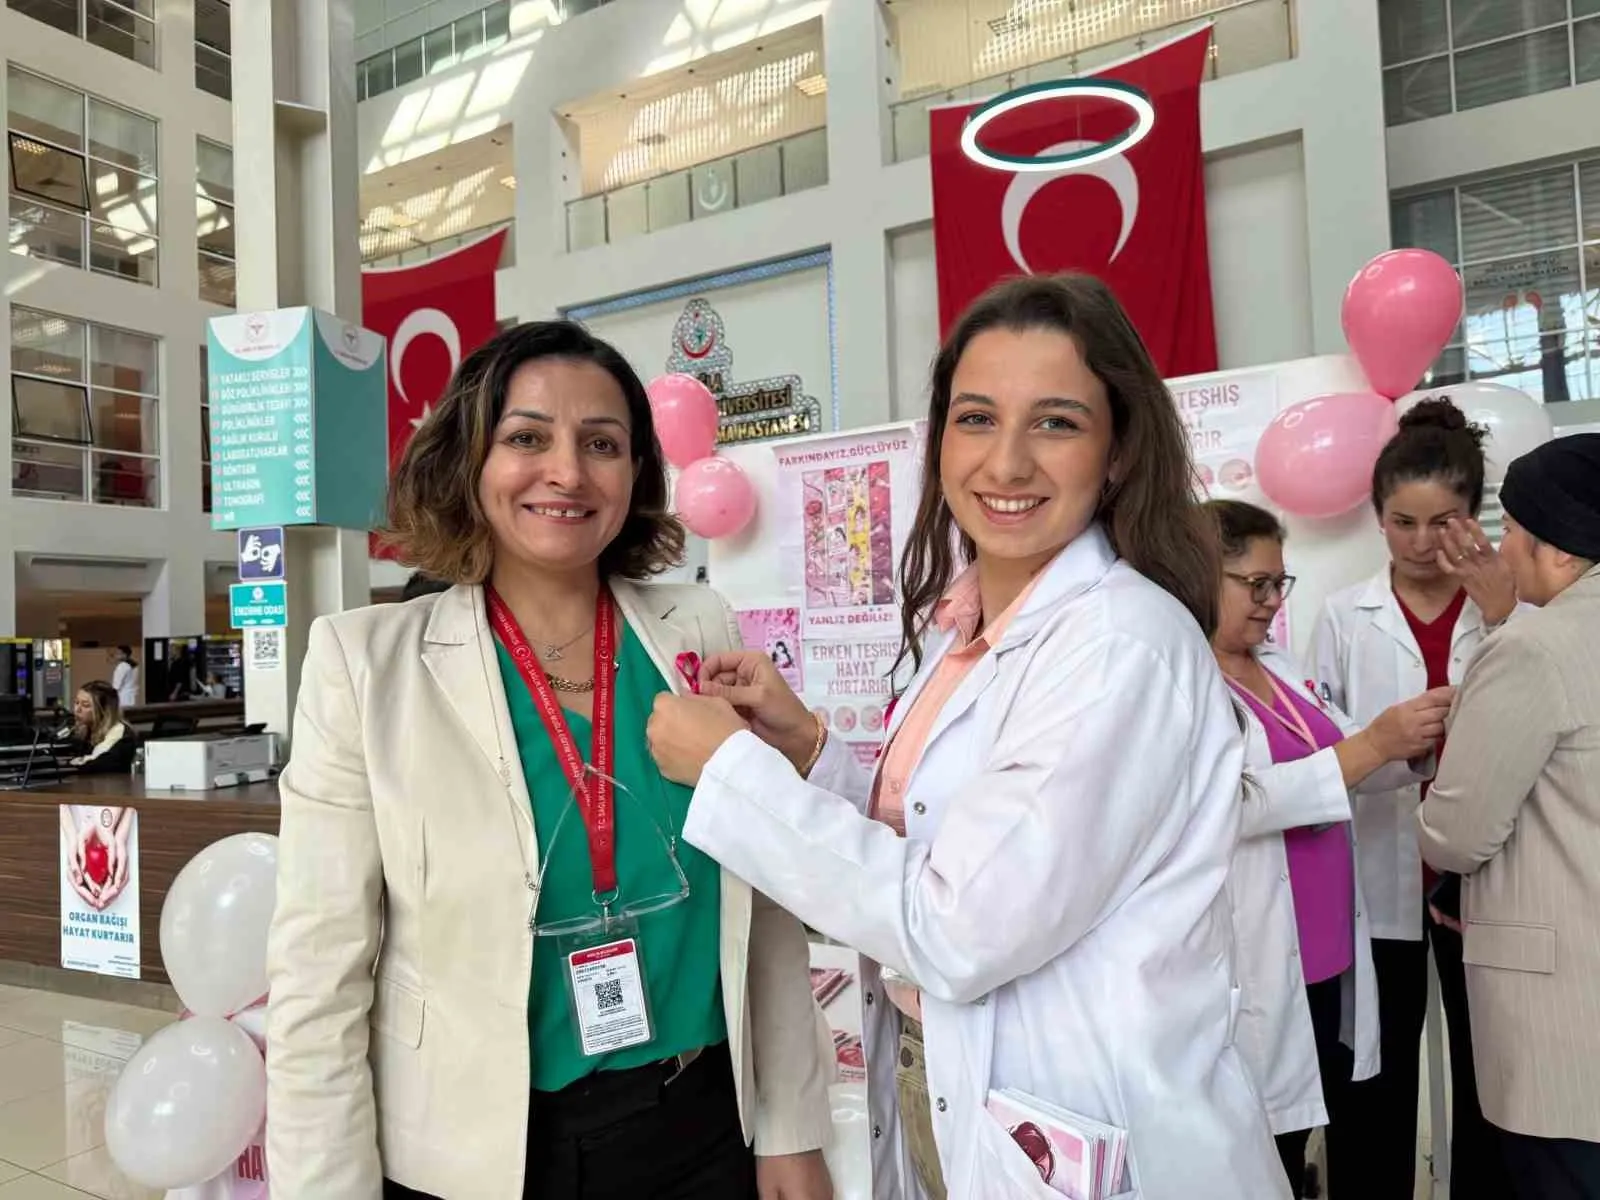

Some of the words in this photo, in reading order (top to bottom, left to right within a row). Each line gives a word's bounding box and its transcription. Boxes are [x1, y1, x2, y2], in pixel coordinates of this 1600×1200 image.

[812, 643, 852, 661] ERKEN
[836, 660, 875, 677] HAYAT
[827, 679, 890, 697] KURTARIR
[69, 911, 97, 924] ORGAN
[63, 925, 90, 937] HAYAT
[91, 928, 134, 944] KURTARIR
